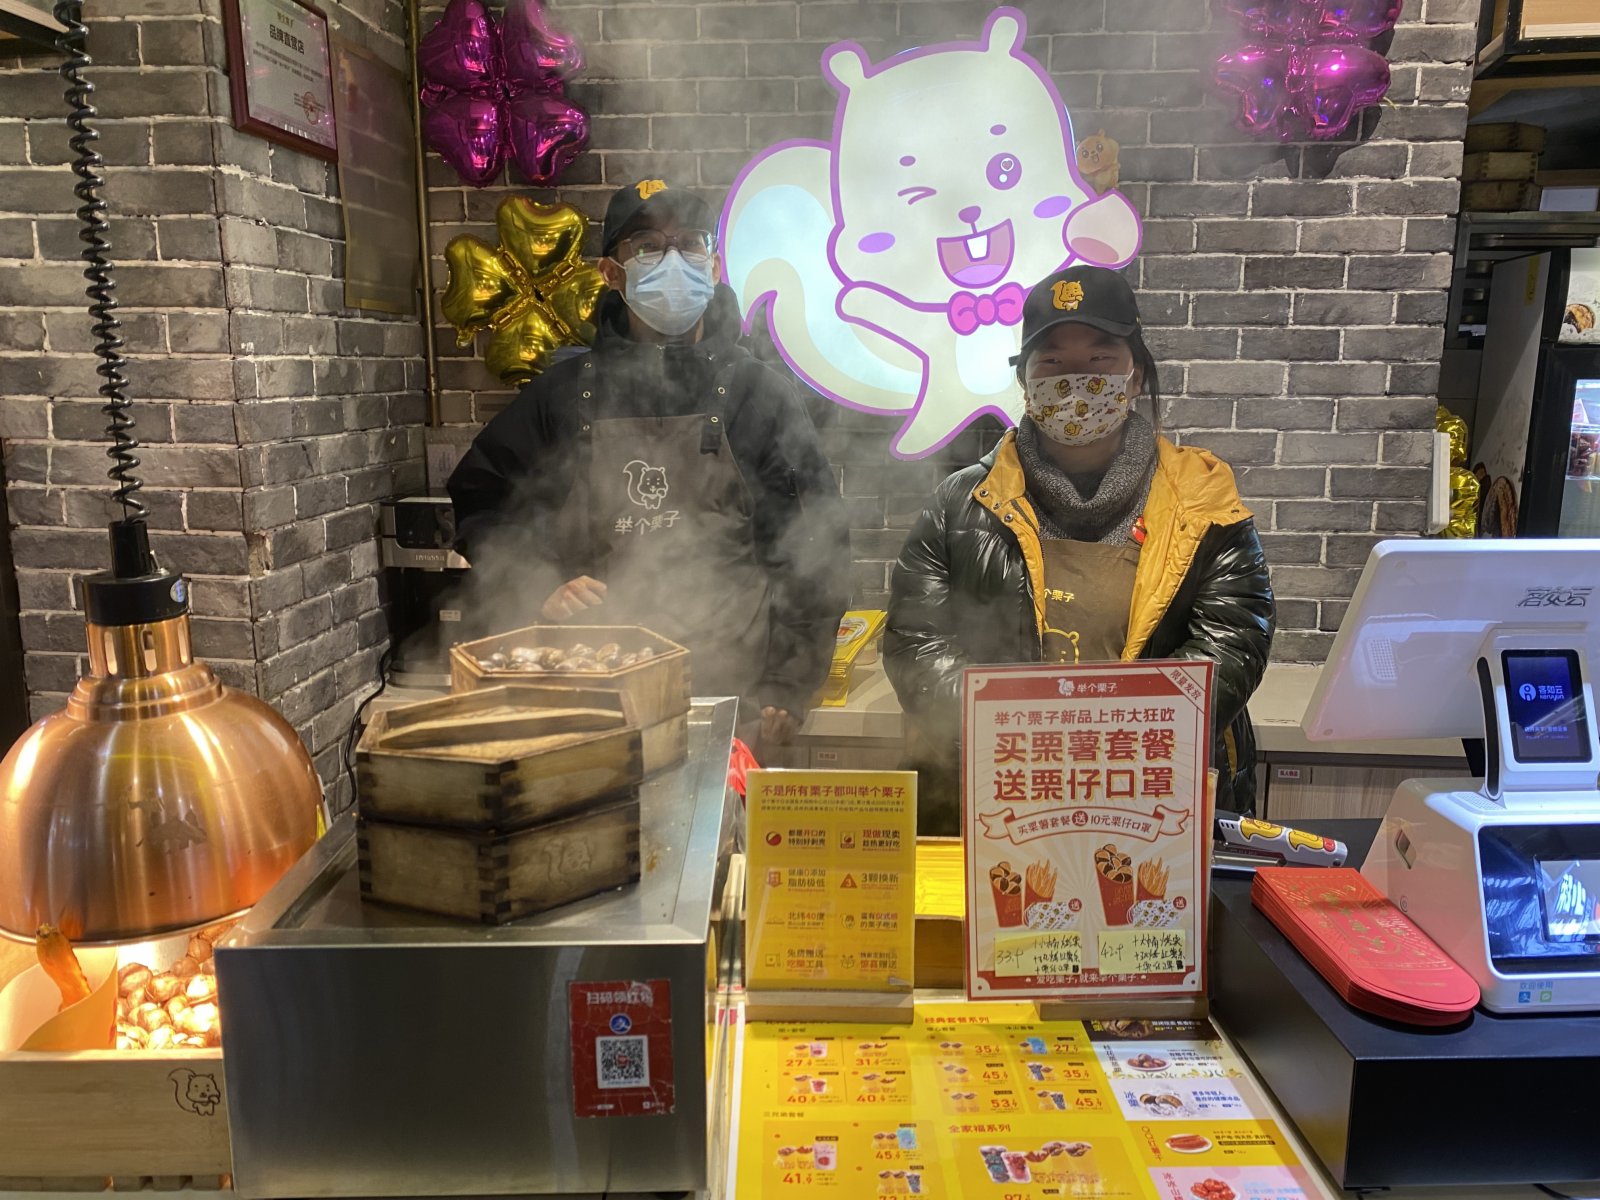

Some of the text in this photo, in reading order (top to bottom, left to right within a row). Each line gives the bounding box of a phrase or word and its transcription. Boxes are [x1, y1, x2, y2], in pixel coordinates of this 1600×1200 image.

[615, 511, 680, 535] 举个栗子
[1077, 682, 1118, 694] 举个栗子
[994, 728, 1176, 763] 买栗薯套餐
[762, 785, 906, 797] 不是所有栗子都叫举个栗子
[993, 766, 1175, 801] 送栗仔口罩
